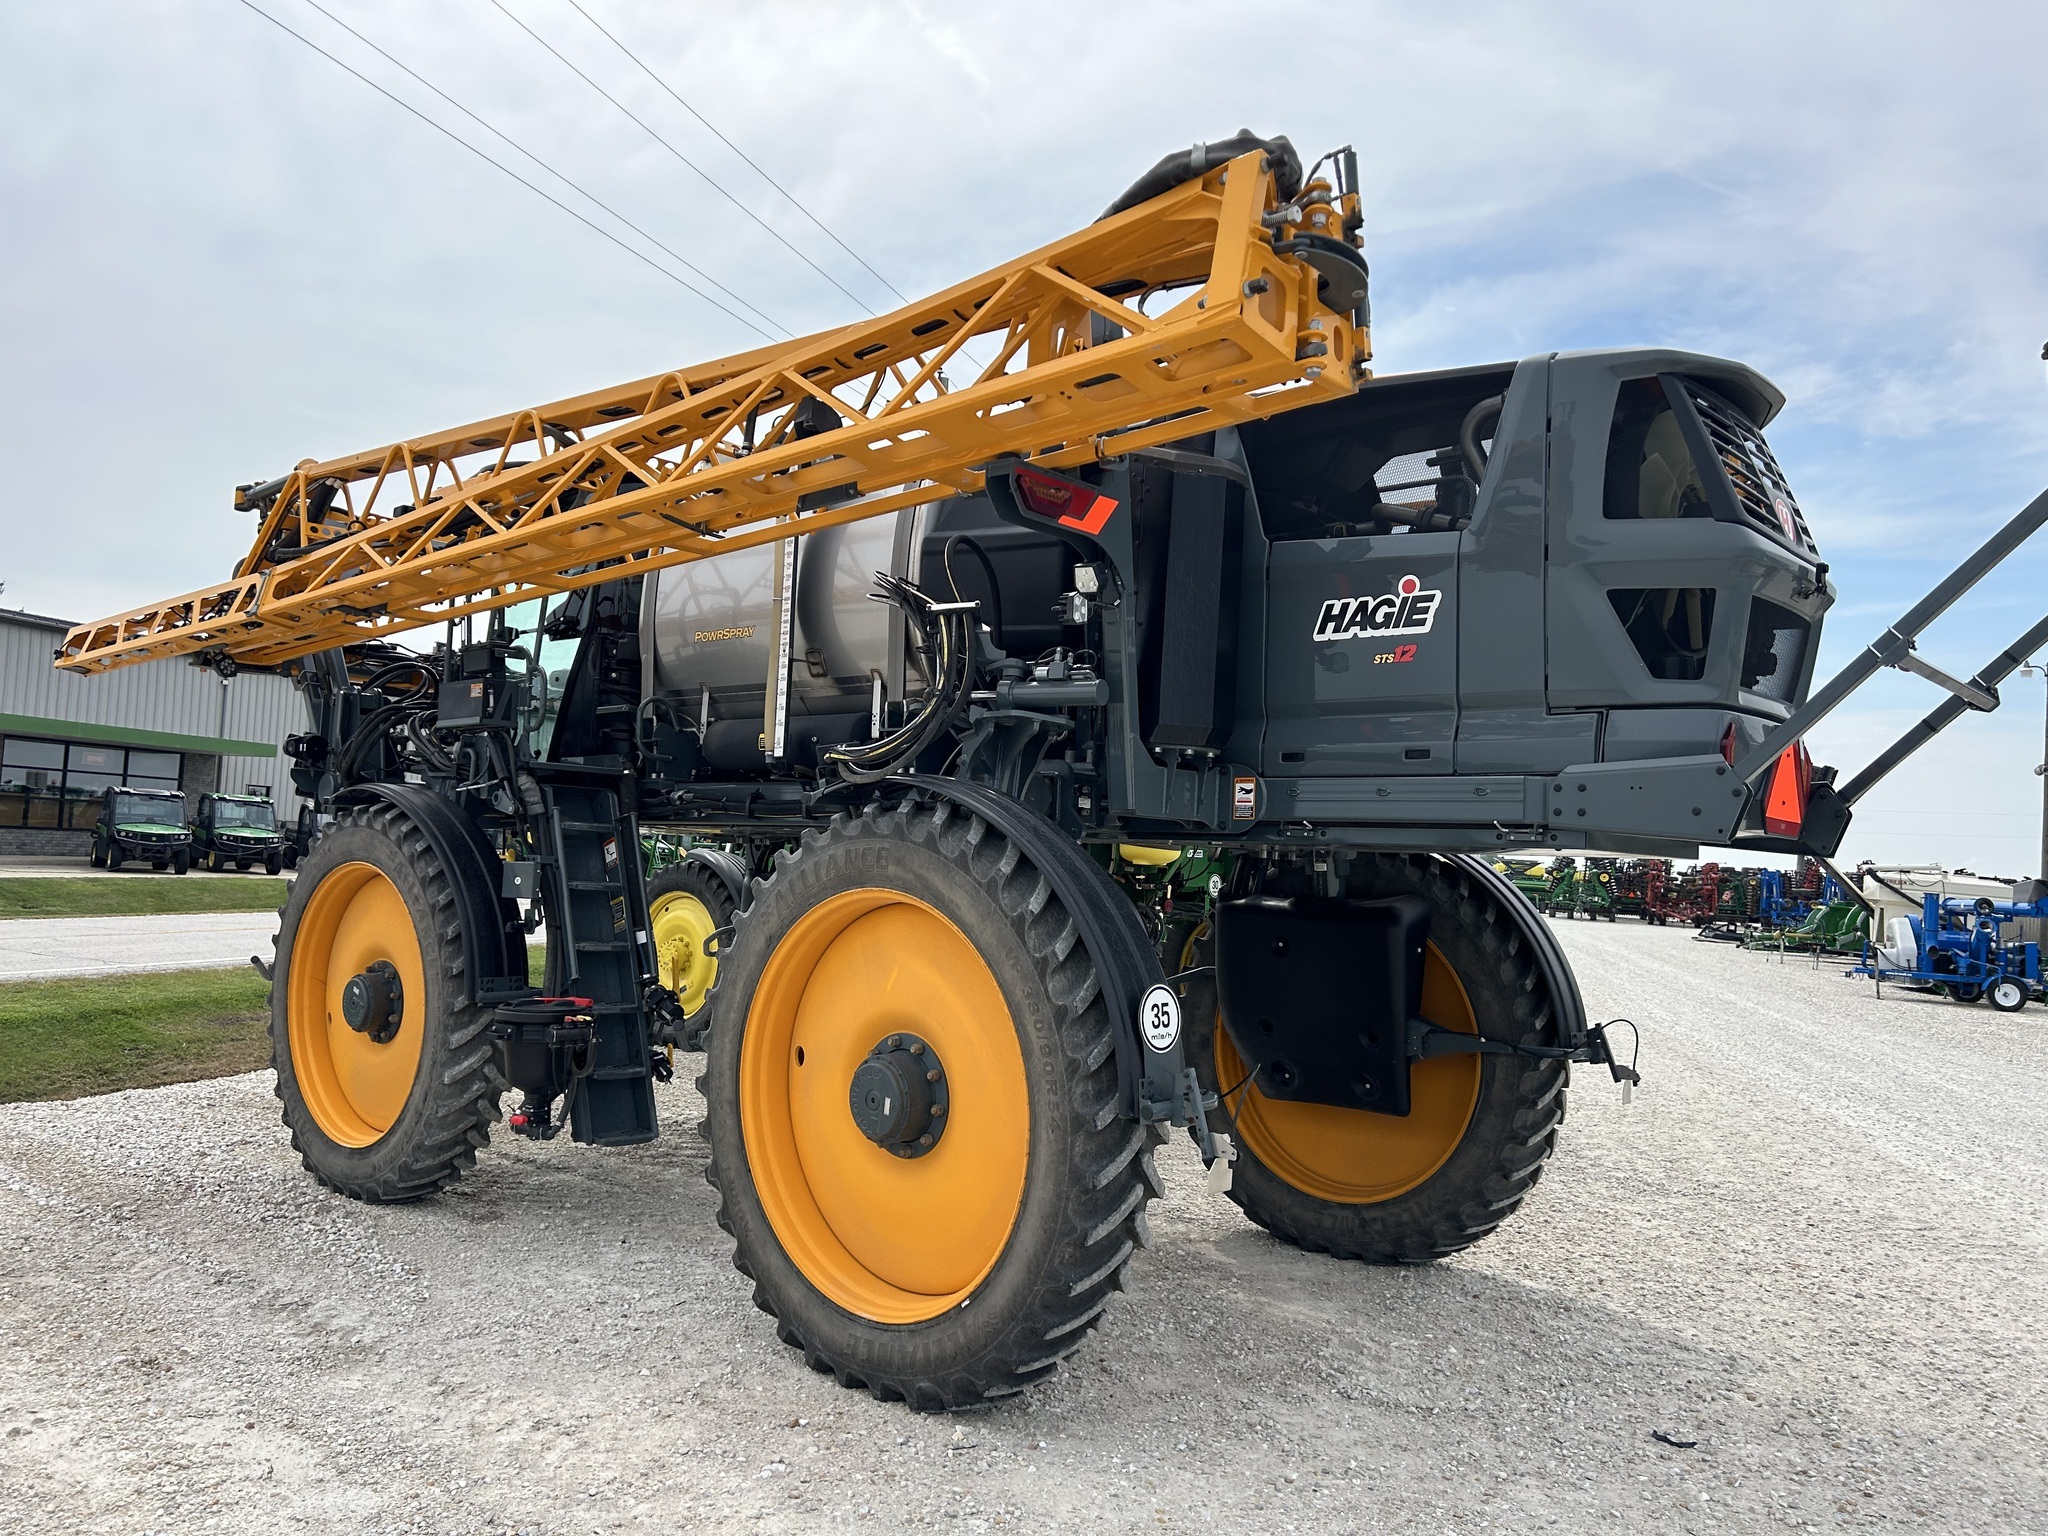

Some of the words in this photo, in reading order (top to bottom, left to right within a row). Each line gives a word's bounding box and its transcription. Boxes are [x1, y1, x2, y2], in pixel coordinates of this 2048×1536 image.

[1315, 577, 1438, 636] HAGIE
[1373, 644, 1418, 664] STS12
[774, 845, 890, 922] ALLIANCE
[1151, 1002, 1171, 1030] 35
[1151, 1032, 1173, 1041] mile/h
